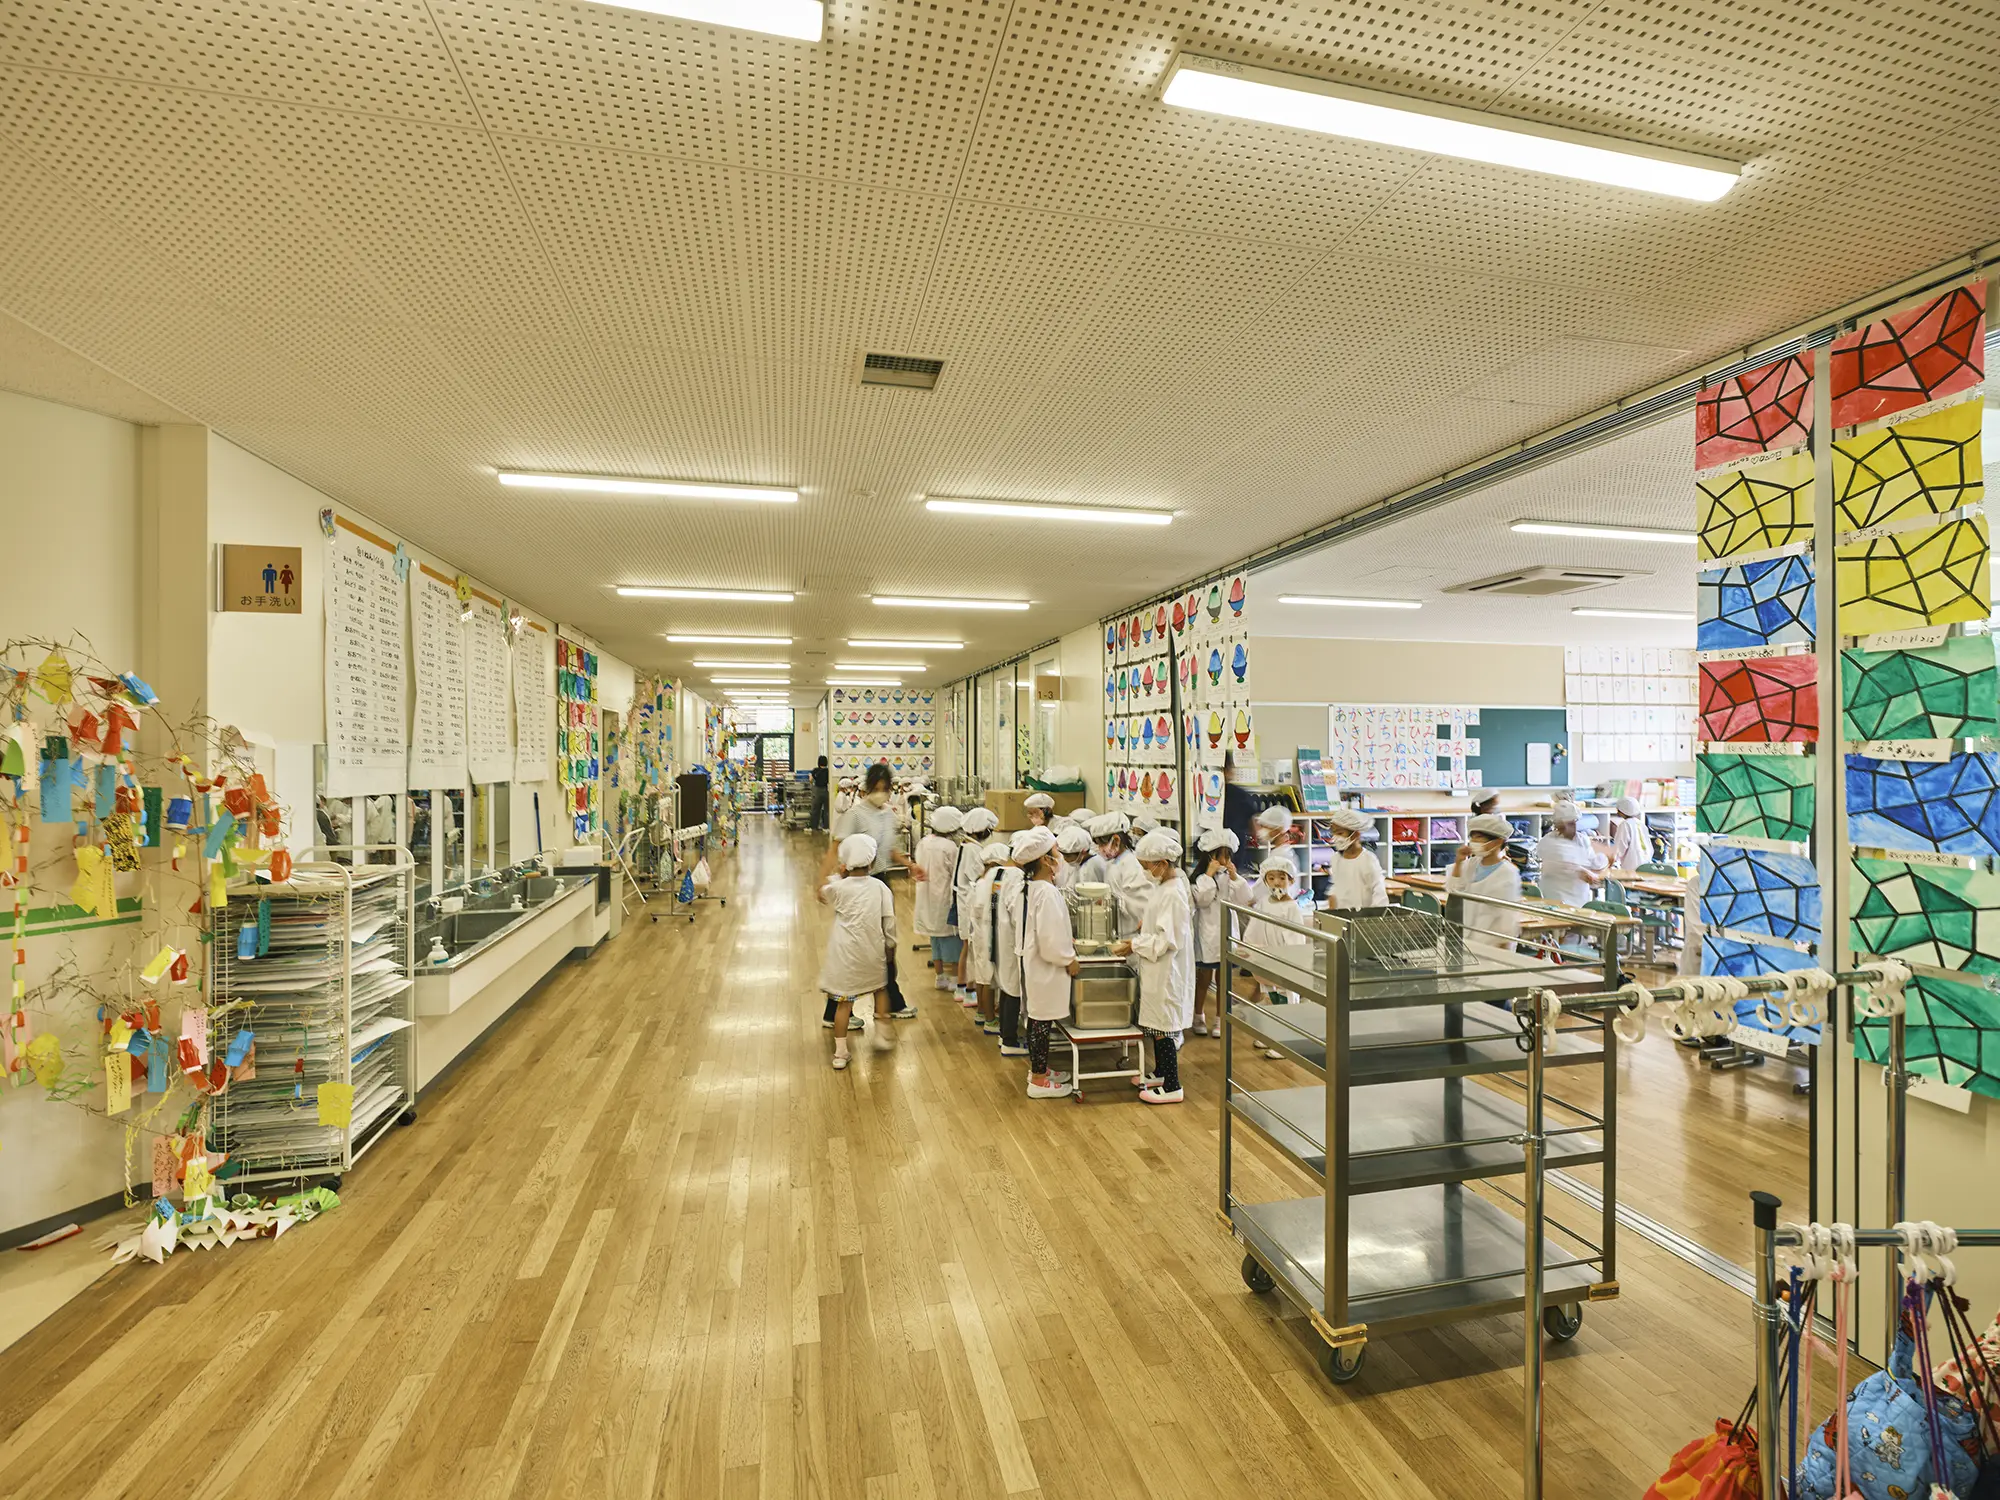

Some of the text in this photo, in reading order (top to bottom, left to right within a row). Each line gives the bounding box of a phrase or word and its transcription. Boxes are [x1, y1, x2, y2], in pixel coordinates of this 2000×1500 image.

[240, 595, 296, 607] お手洗い
[1038, 690, 1053, 699] 1-3
